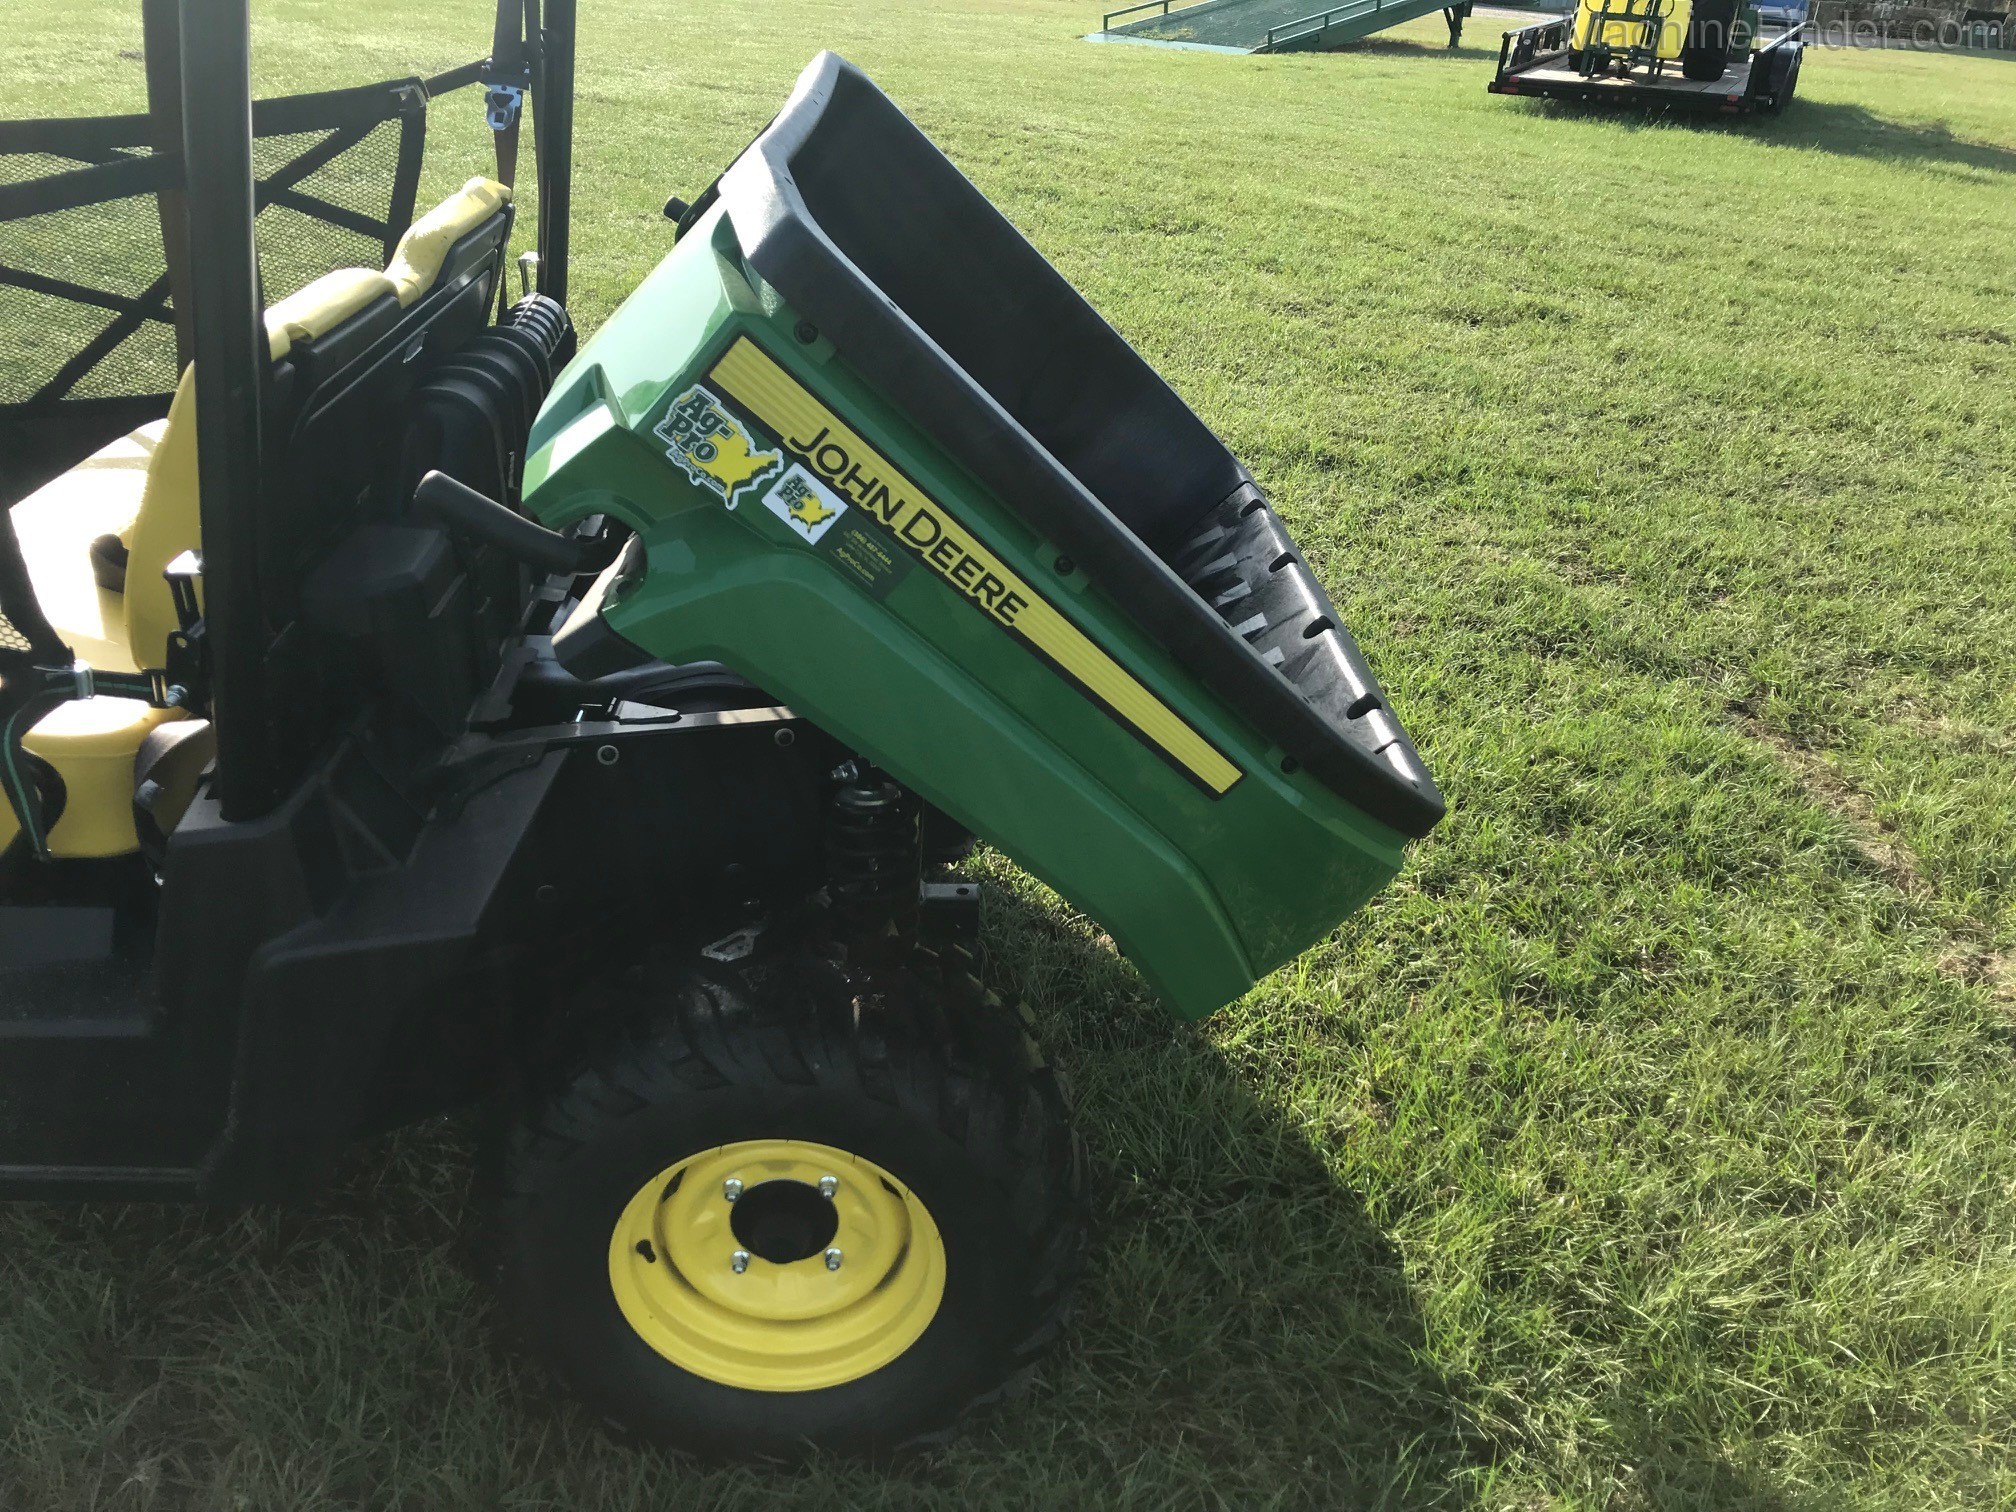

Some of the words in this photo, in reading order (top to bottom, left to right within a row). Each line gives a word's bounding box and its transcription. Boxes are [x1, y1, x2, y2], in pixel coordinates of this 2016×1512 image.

[659, 411, 718, 463] Pro
[675, 391, 735, 440] Ag-
[669, 448, 726, 494] AgProCo.com
[789, 427, 905, 523] JOHN
[900, 508, 1029, 623] DEERE
